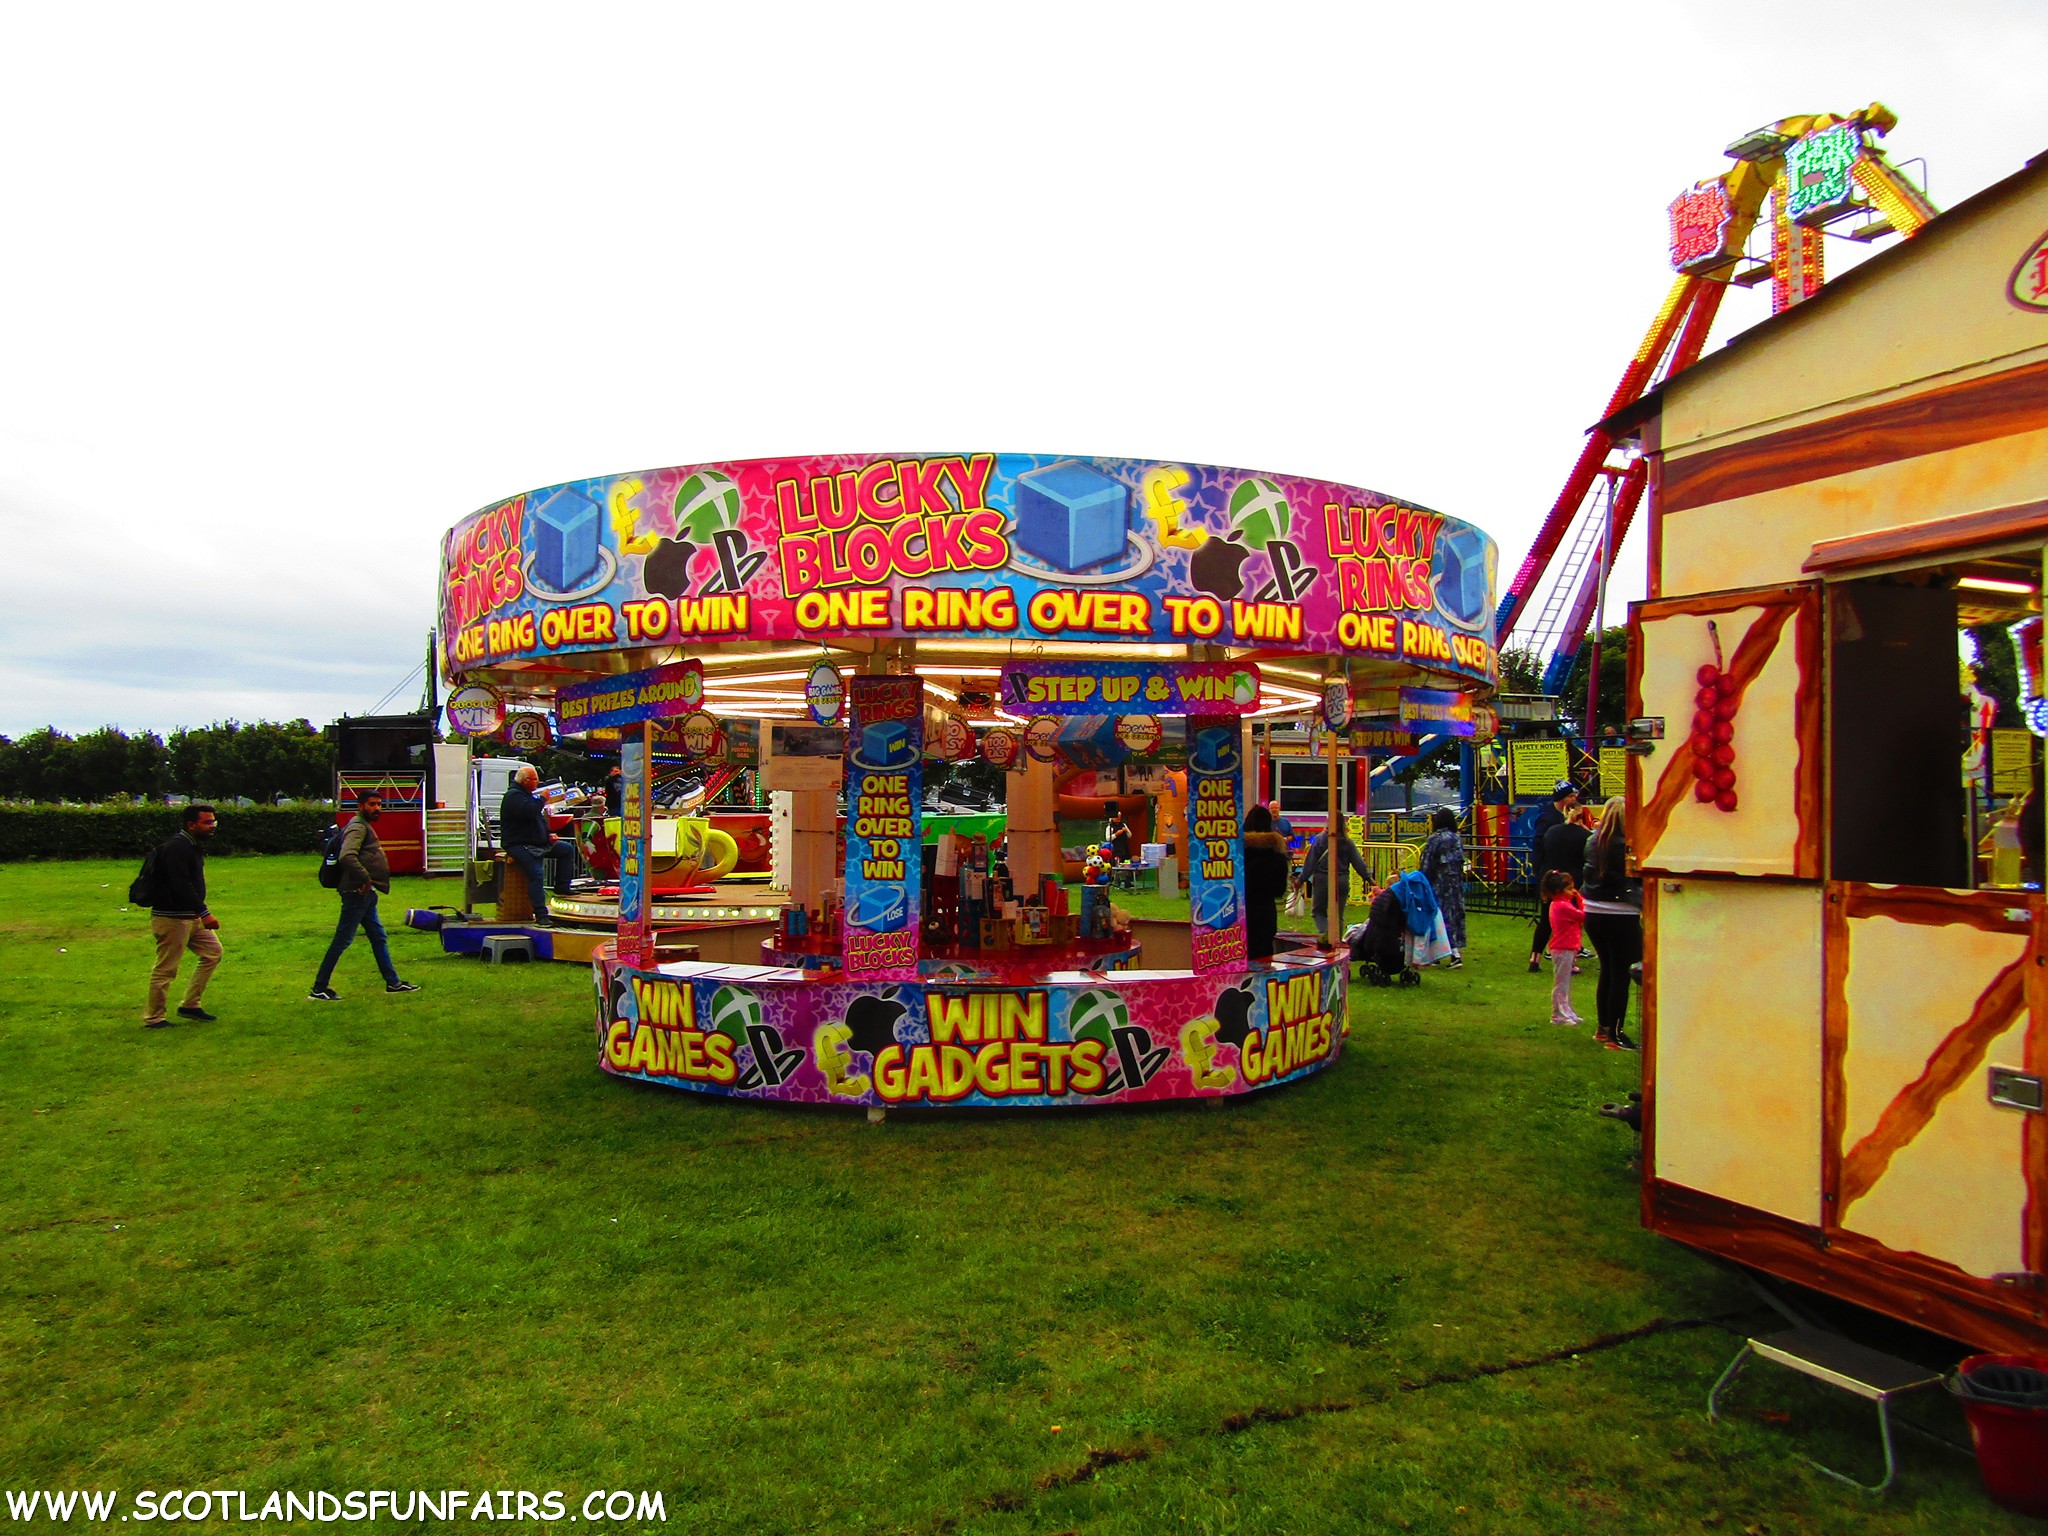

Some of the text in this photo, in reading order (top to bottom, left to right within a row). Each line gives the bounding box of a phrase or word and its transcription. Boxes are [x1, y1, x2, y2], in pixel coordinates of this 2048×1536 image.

[777, 454, 995, 536] LUCKY
[449, 495, 525, 579] LUCKY
[1324, 504, 1444, 560] LUCKY
[779, 509, 1008, 598] BLOCKS
[451, 549, 524, 628] RINGS
[1336, 555, 1432, 613] RINGS
[795, 587, 1303, 643] ONE RING OVER TO WIN
[456, 594, 749, 662] ONE RING OVER TO WIN
[1338, 612, 1396, 652] ONE
[1402, 620, 1451, 667] RING
[1452, 632, 1487, 675] OVER
[808, 685, 843, 697] BIG GAMES
[853, 682, 918, 704] LUCKY
[1029, 673, 1236, 702] STEP UP & WIN
[561, 698, 588, 719] BEST
[592, 688, 635, 713] PRIZES
[637, 678, 695, 704] AROUND
[454, 708, 497, 726] WIN
[859, 701, 917, 724] RINGS
[1404, 703, 1418, 719] BEST
[514, 722, 540, 740] £1
[593, 728, 619, 739] BEST
[1117, 725, 1157, 734] BIG GAMES
[1355, 732, 1370, 746] STEP
[1372, 733, 1383, 745] UP
[1395, 732, 1410, 745] WIN
[684, 733, 713, 750] WIN
[889, 739, 905, 752] WIN
[988, 736, 1007, 747] TOO
[987, 747, 1010, 758] EASY
[624, 782, 640, 800] ONE
[861, 776, 908, 794] ONE
[1199, 779, 1233, 796] ONE
[624, 801, 640, 819] RING
[859, 797, 911, 815] RING
[1197, 800, 1236, 818] RING
[623, 820, 641, 838] OVER
[855, 817, 914, 838] OVER
[1195, 819, 1238, 838] OVER
[1397, 819, 1429, 833] Pleas
[627, 839, 637, 853] TO
[869, 839, 899, 858] TO
[1206, 840, 1228, 859] TO
[625, 857, 638, 875] WIN
[863, 861, 904, 880] WIN
[1202, 861, 1233, 879] WIN
[887, 907, 903, 921] LOSE
[1222, 904, 1235, 917] LOSE
[849, 931, 911, 951] LUCKY
[1196, 926, 1241, 949] LUCKY
[848, 948, 915, 972] BLOCKS
[1197, 941, 1245, 969] BLOCKS
[632, 976, 694, 1030] WIN
[1267, 970, 1321, 1028] WIN
[925, 992, 1048, 1045] WIN
[607, 1019, 738, 1085] GAMES
[1240, 1009, 1333, 1085] GAMES
[873, 1040, 1107, 1102] GADGETS
